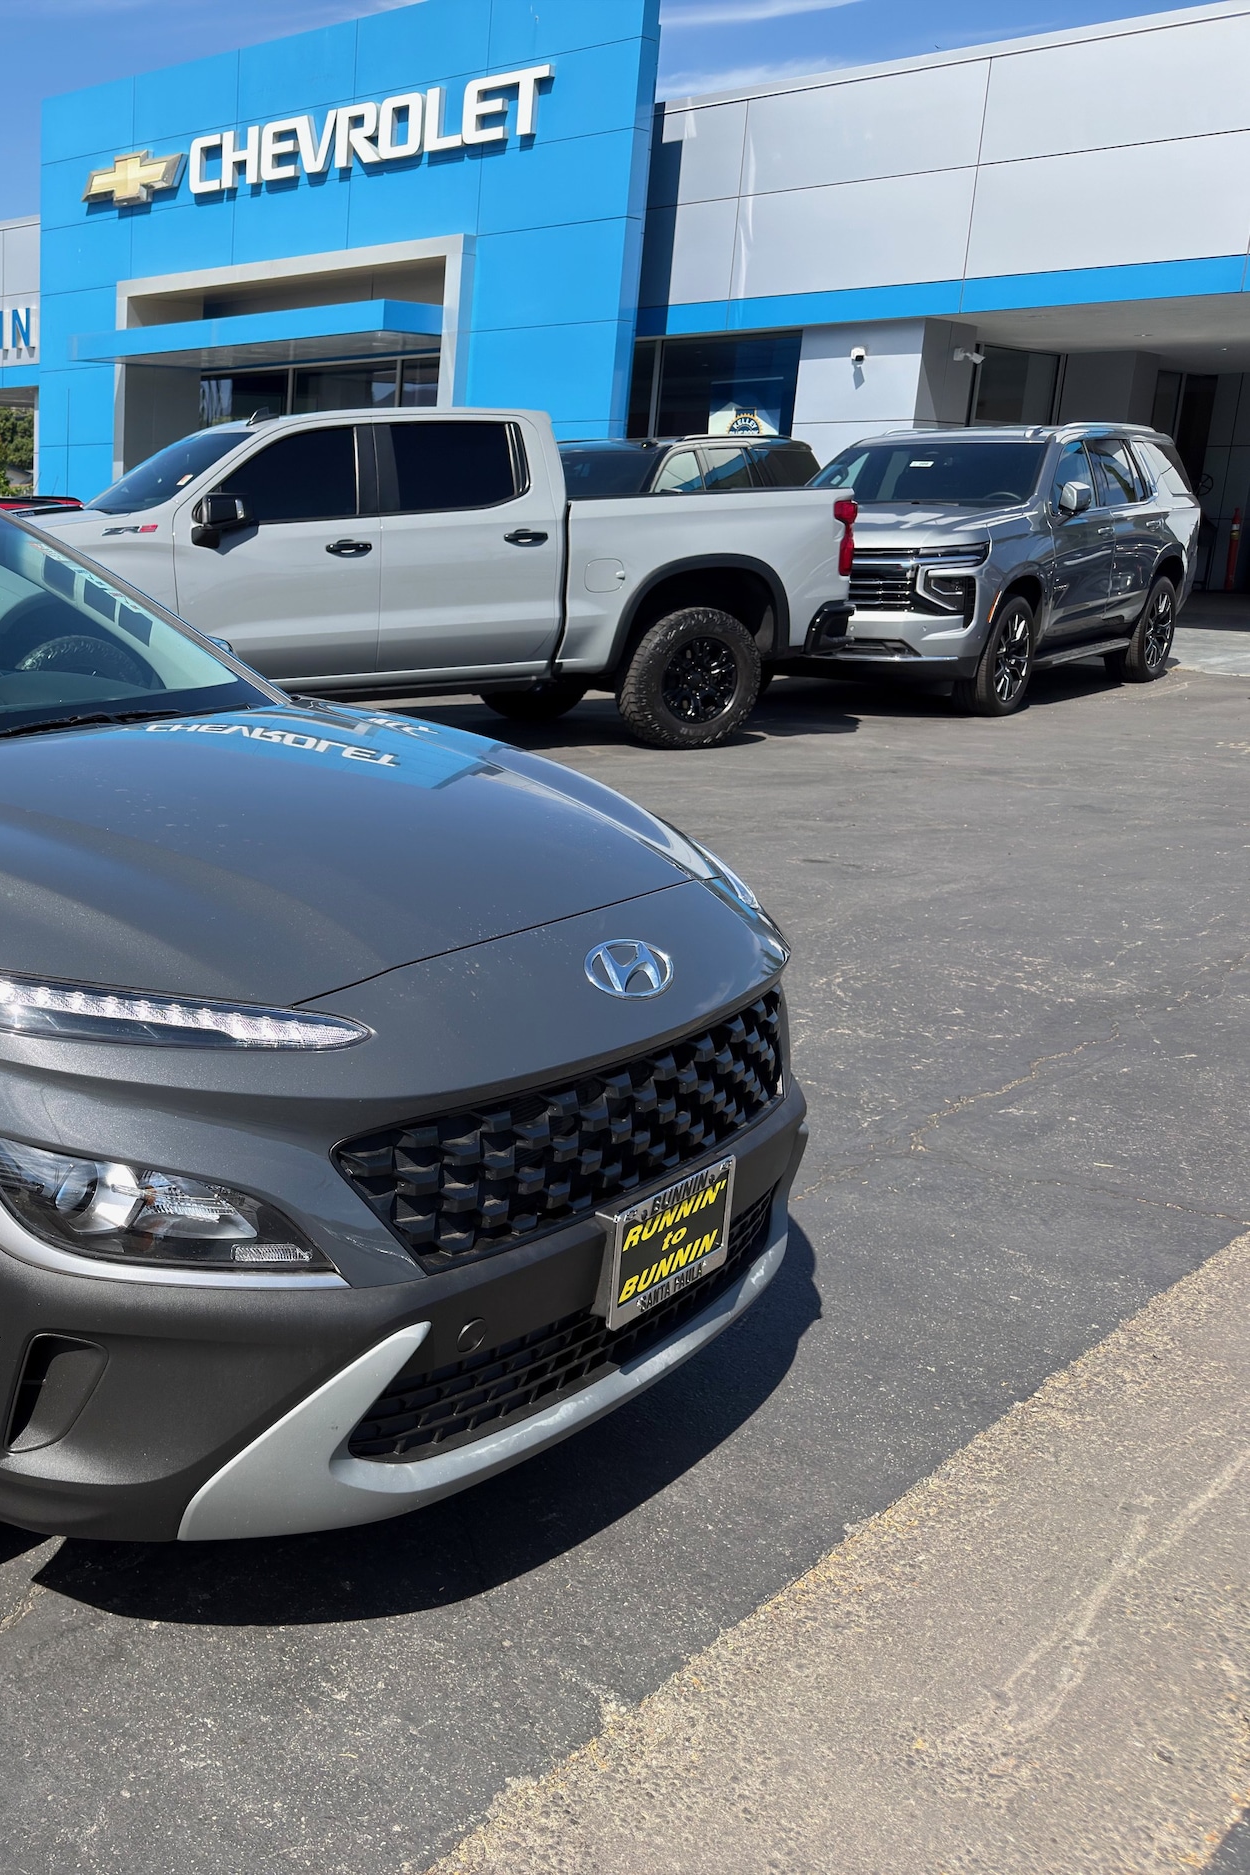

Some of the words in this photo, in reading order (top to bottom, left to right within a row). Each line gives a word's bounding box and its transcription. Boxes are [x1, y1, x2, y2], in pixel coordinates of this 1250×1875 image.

[189, 63, 554, 194] CHEVROLET
[732, 418, 758, 429] KELLEY
[622, 1178, 727, 1252] RUNNIN'
[652, 1169, 709, 1214] BUNNIN
[618, 1228, 718, 1303] BUNNIN
[661, 1227, 687, 1251] to
[636, 1281, 671, 1312] SANTA
[673, 1258, 707, 1293] PAULA
